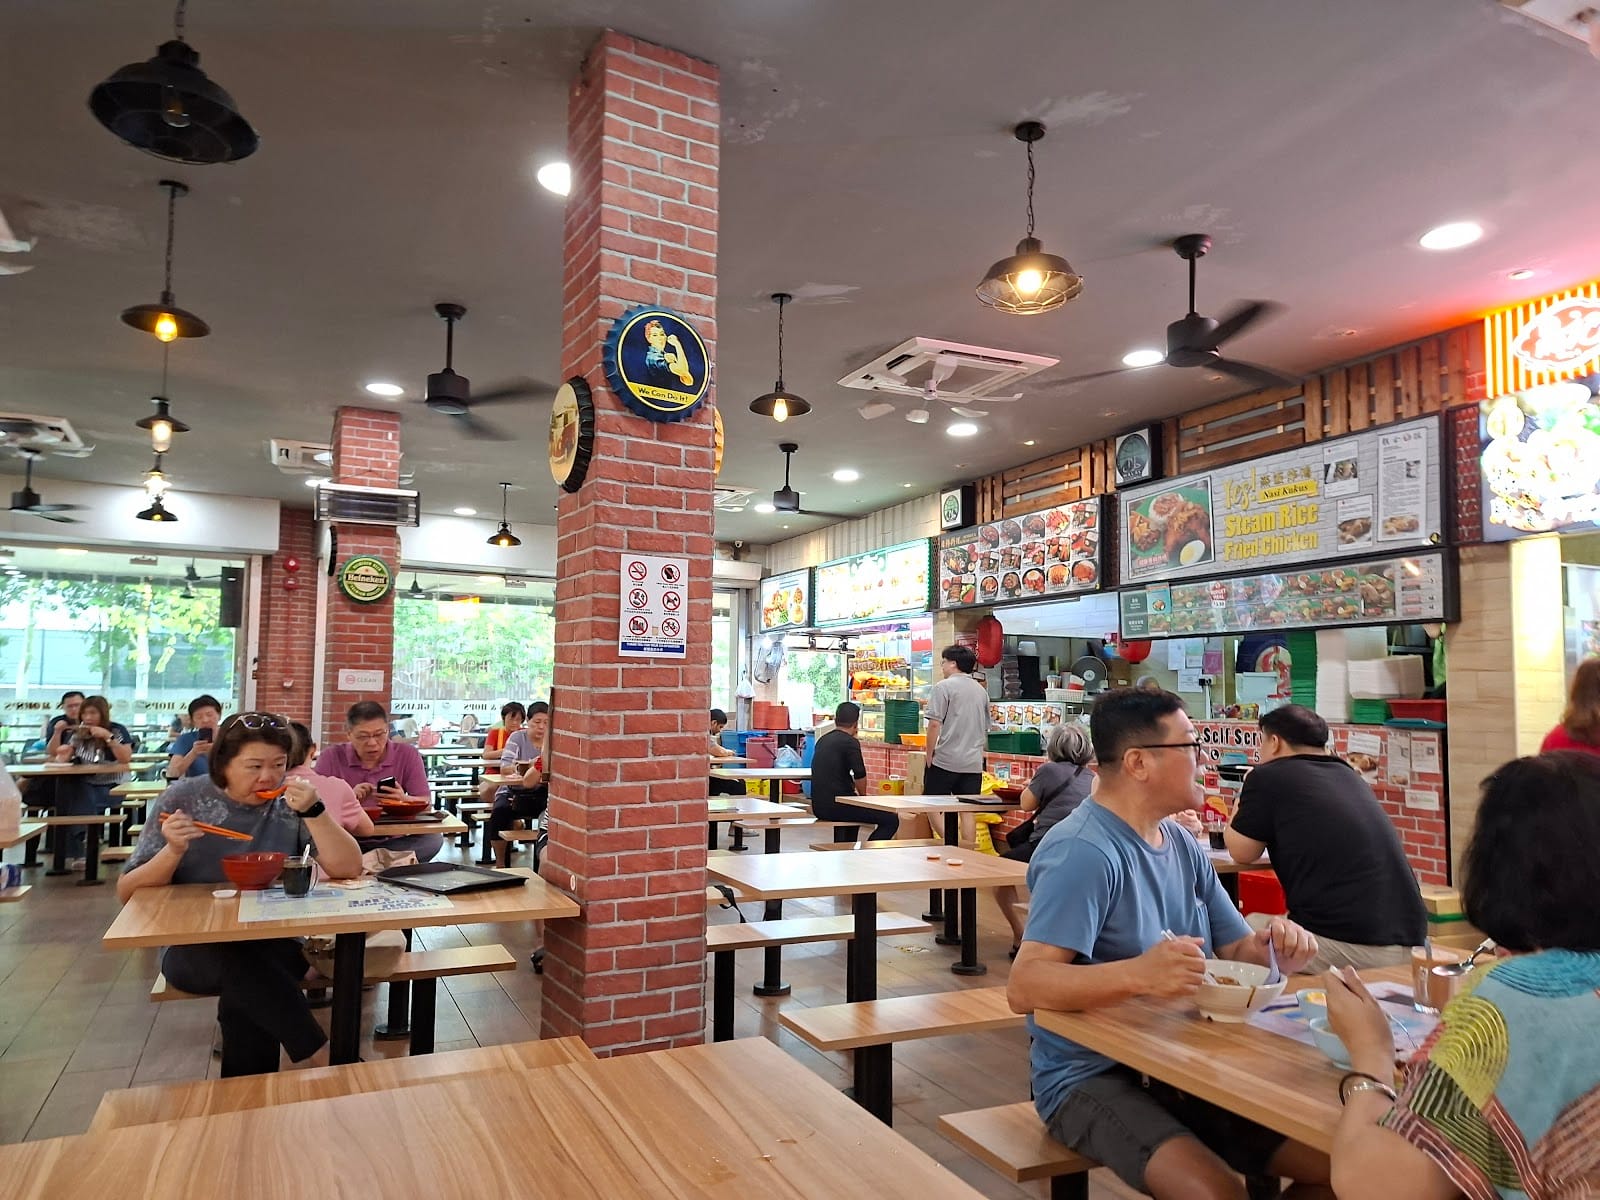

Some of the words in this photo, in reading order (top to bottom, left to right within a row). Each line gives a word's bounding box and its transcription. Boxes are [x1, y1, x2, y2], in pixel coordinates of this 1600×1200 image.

[638, 387, 650, 395] We
[651, 390, 666, 398] Can
[667, 393, 678, 401] Do
[679, 395, 688, 403] It!
[1224, 467, 1256, 511] Yes!
[1264, 489, 1280, 499] Nasi
[1282, 484, 1308, 496] Kukus
[1224, 512, 1276, 538] Steam
[1279, 502, 1318, 529] Rice
[1224, 537, 1259, 562] Fried
[1261, 530, 1318, 556] Chicken
[348, 573, 385, 584] Heineken
[1203, 727, 1231, 744] Self
